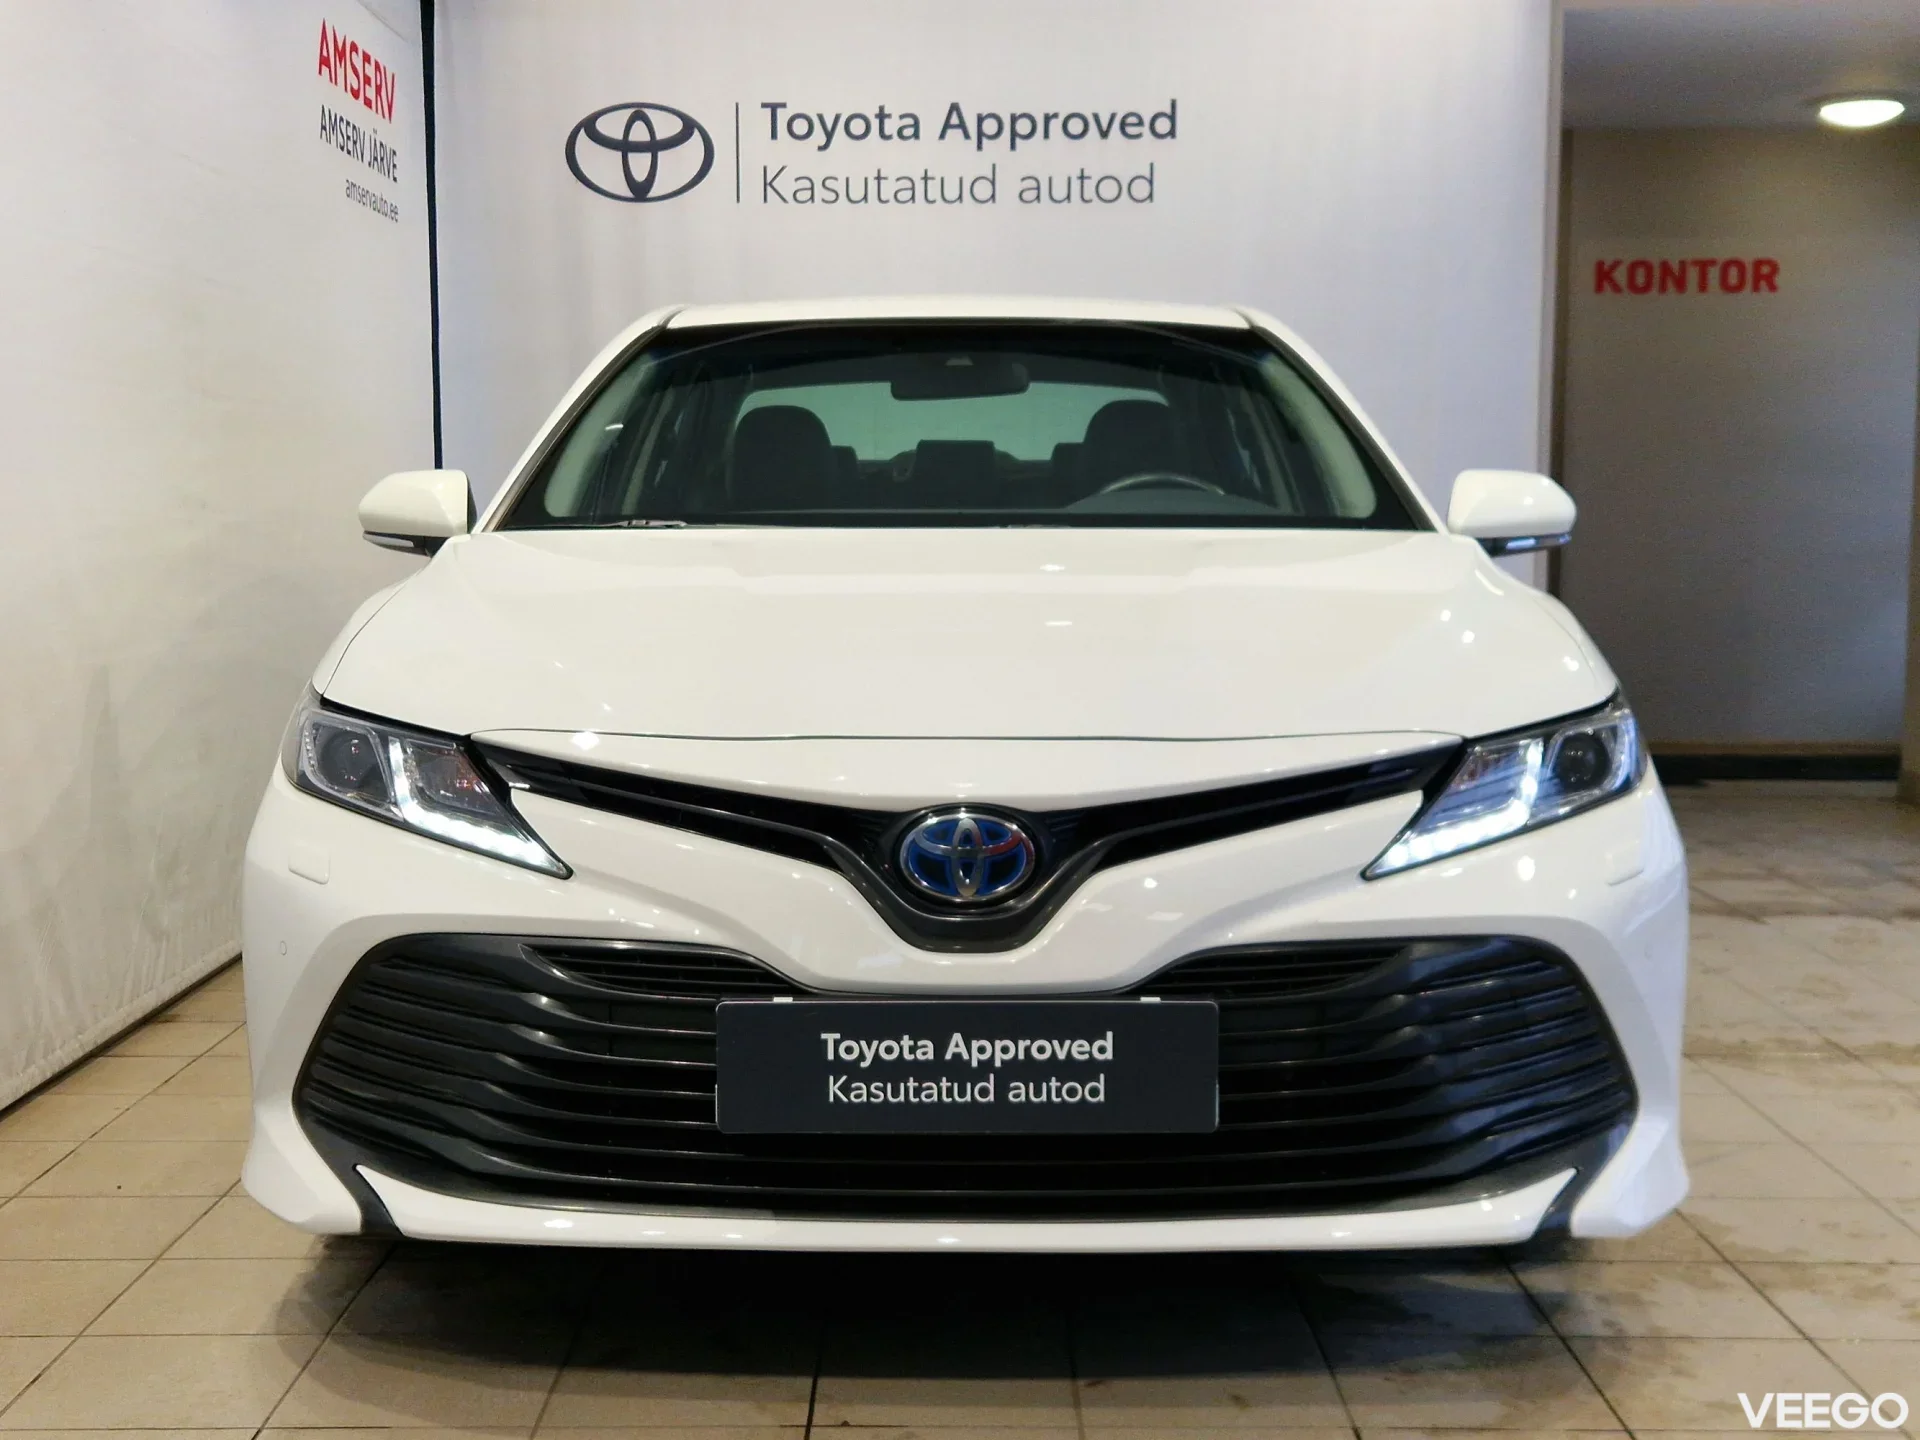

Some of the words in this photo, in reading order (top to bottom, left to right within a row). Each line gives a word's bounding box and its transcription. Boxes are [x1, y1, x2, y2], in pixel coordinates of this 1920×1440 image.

[318, 18, 395, 124] AMSERV
[320, 104, 365, 163] AMSERV
[368, 128, 398, 183] JÄRVE
[761, 102, 921, 151] Toyota
[938, 99, 1178, 151] Approved
[345, 178, 399, 223] amservauto.ee
[762, 163, 997, 205] Kasutatud
[1018, 162, 1155, 205] autod
[1594, 257, 1780, 295] KONTOR
[821, 1032, 934, 1067] Toyota
[945, 1031, 1114, 1067] Approved
[828, 1073, 995, 1103] Kasutatud
[1008, 1073, 1106, 1103] autod
